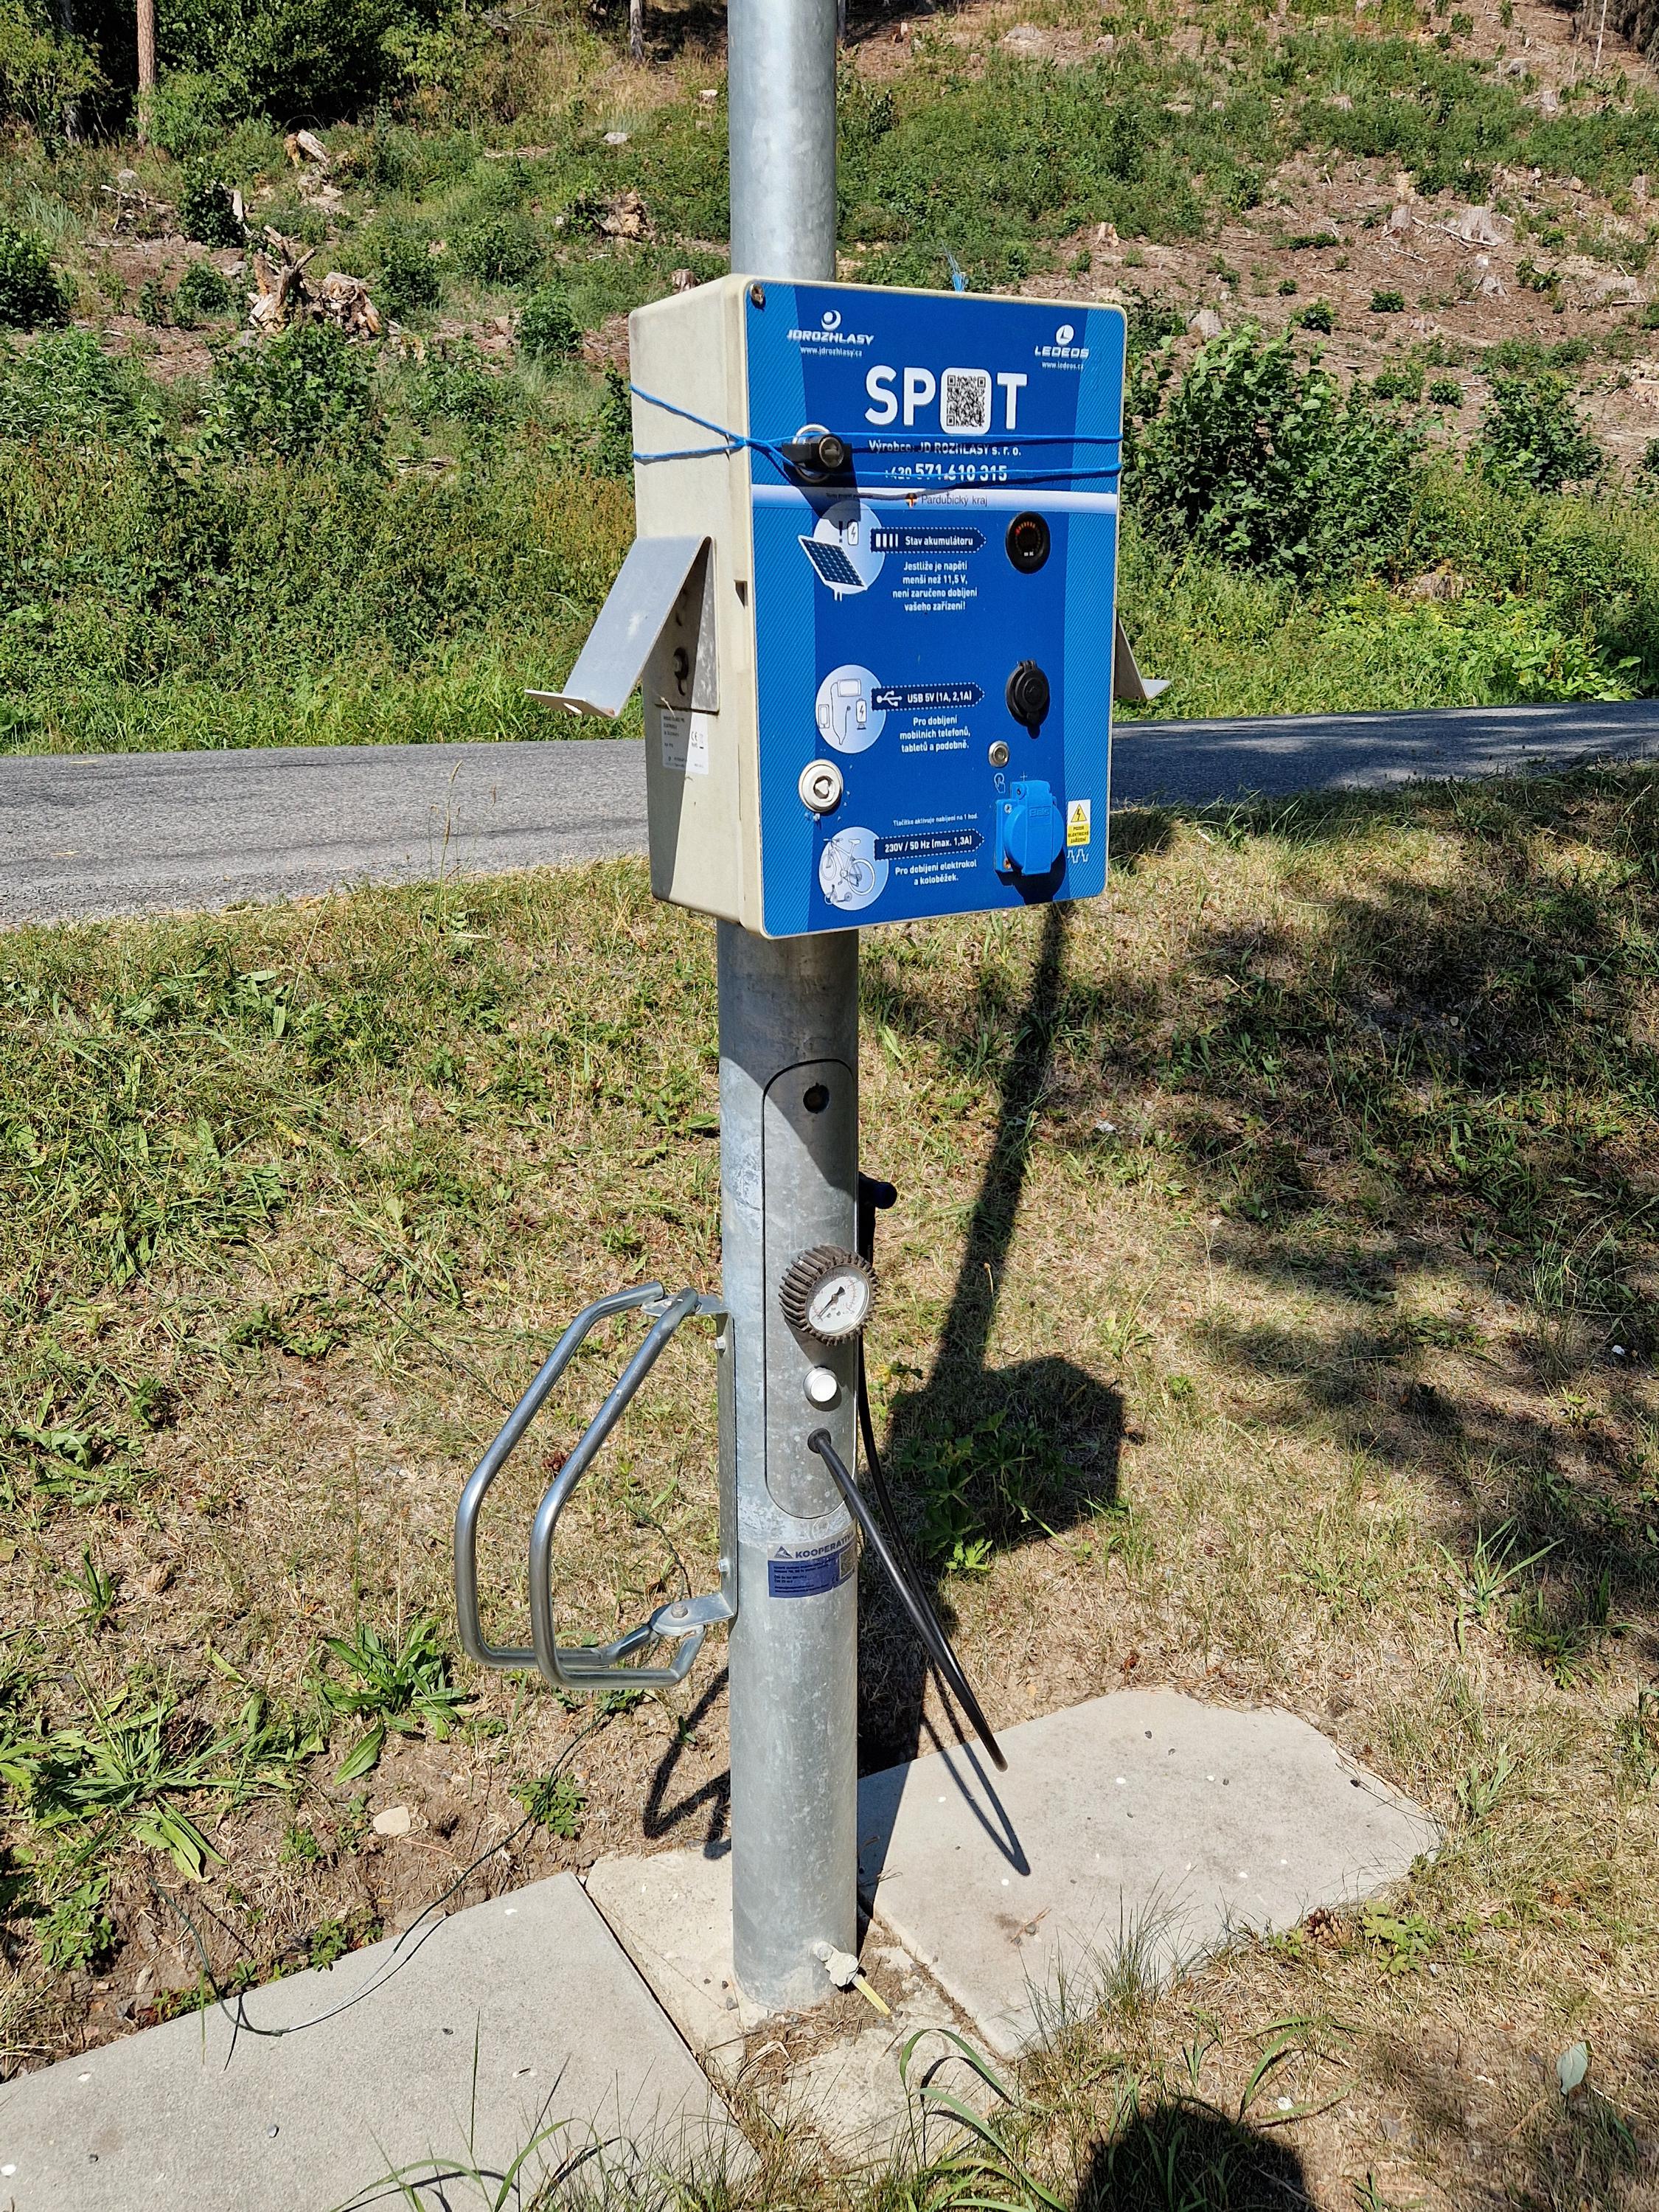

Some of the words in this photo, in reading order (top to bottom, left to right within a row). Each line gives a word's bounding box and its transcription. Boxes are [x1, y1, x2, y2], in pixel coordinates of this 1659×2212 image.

[1034, 345, 1089, 360] LEDEOS
[918, 442, 931, 453] JD
[934, 442, 990, 455] ROZHLASY
[992, 446, 1001, 456] s.
[1004, 447, 1010, 456] r.
[1012, 447, 1022, 456] o.
[915, 463, 942, 481] 571
[947, 464, 976, 482] 610
[980, 465, 1008, 481] 315
[921, 493, 969, 507] Pardubický
[972, 495, 989, 507] kraj
[905, 535, 922, 546] Stav
[924, 535, 973, 546] akumulátoru
[904, 560, 933, 571] Jestliže
[935, 562, 942, 572] je
[943, 560, 967, 572] napětí
[902, 574, 926, 585] menší
[928, 574, 941, 585] než
[944, 574, 959, 585] 11,5
[960, 574, 967, 585] V,
[892, 588, 909, 598] není
[911, 588, 946, 598] zaručeno
[904, 602, 931, 611] vašeho
[908, 693, 923, 703] USB
[925, 693, 935, 703] 5V
[936, 692, 951, 703] (1A,
[953, 690, 972, 702] 2,1A)
[913, 717, 926, 726] Pro
[900, 729, 936, 740] mobilních
[938, 726, 970, 738] telefonů,
[901, 741, 928, 753] tabletů
[936, 740, 970, 752] podobně.
[885, 842, 903, 853] 230V
[904, 841, 908, 852] /
[910, 841, 919, 850] 50
[920, 840, 930, 849] Hz
[931, 838, 952, 849] (max.
[954, 835, 972, 846] 1,3A)
[895, 866, 908, 875] Pro
[940, 859, 977, 871] elektrokol
[919, 873, 959, 885] koloběžek.
